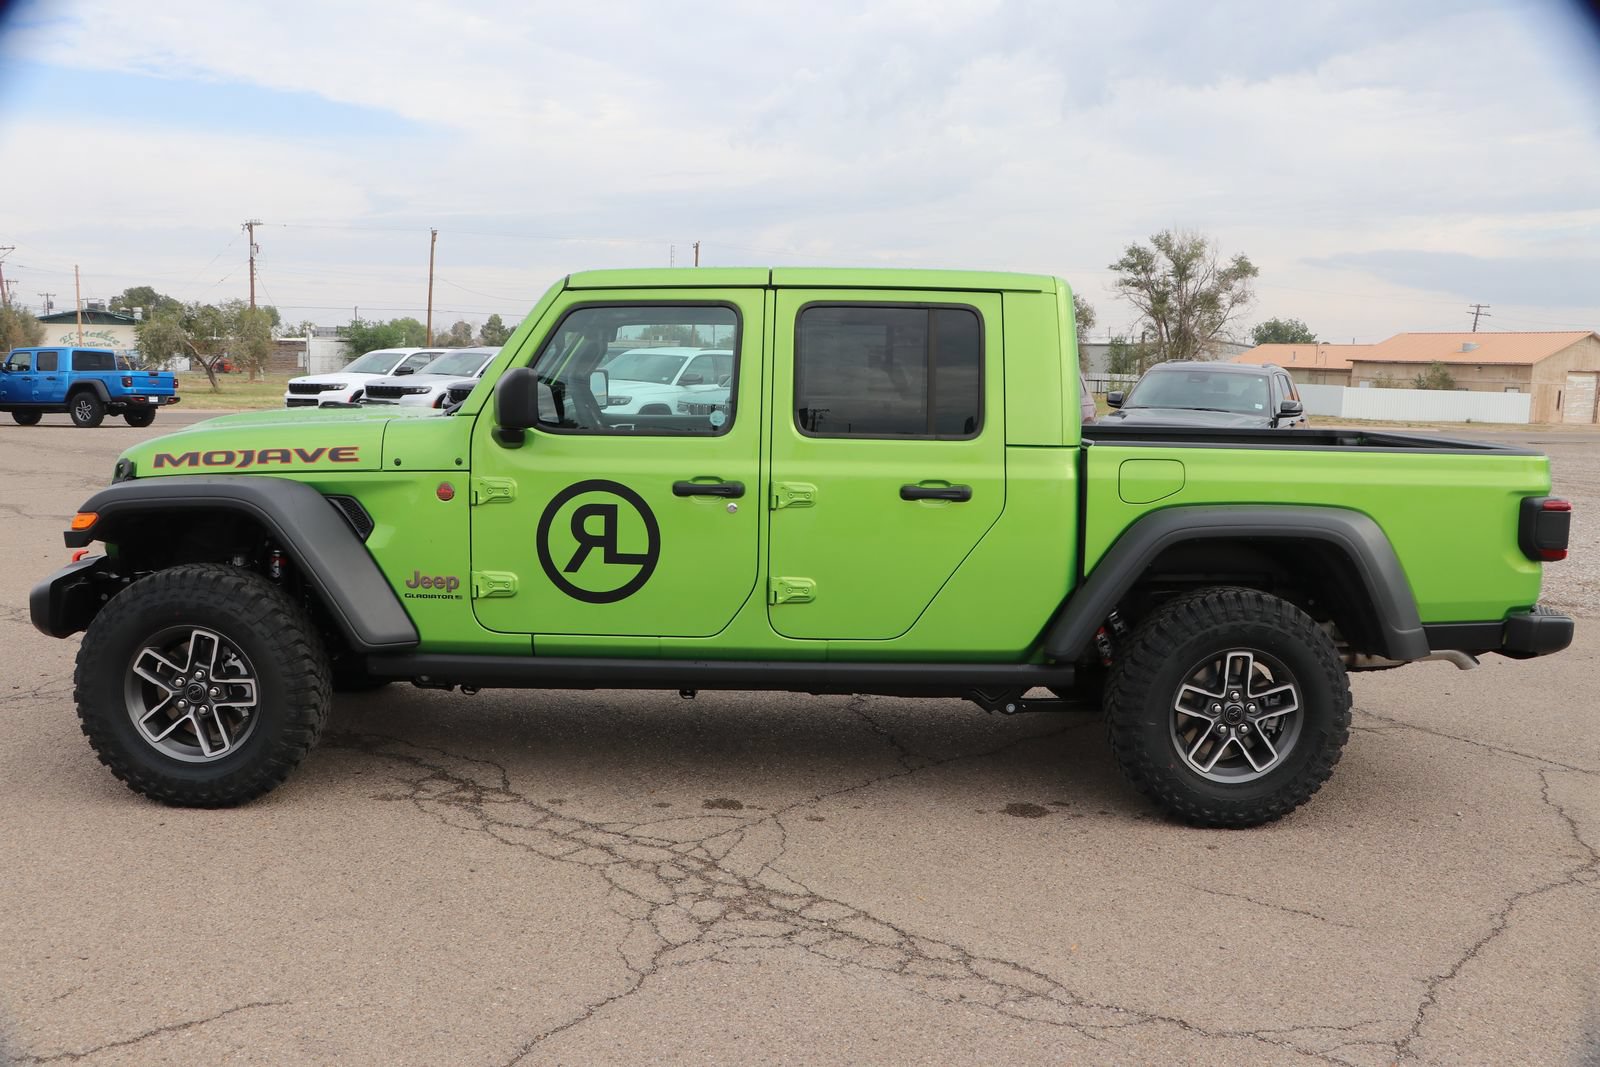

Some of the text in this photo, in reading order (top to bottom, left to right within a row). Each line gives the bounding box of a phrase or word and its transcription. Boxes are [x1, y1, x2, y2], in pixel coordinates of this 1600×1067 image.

[153, 447, 360, 468] MOJAVE
[405, 569, 460, 593] Jeep
[404, 592, 454, 600] GLADIATOR
